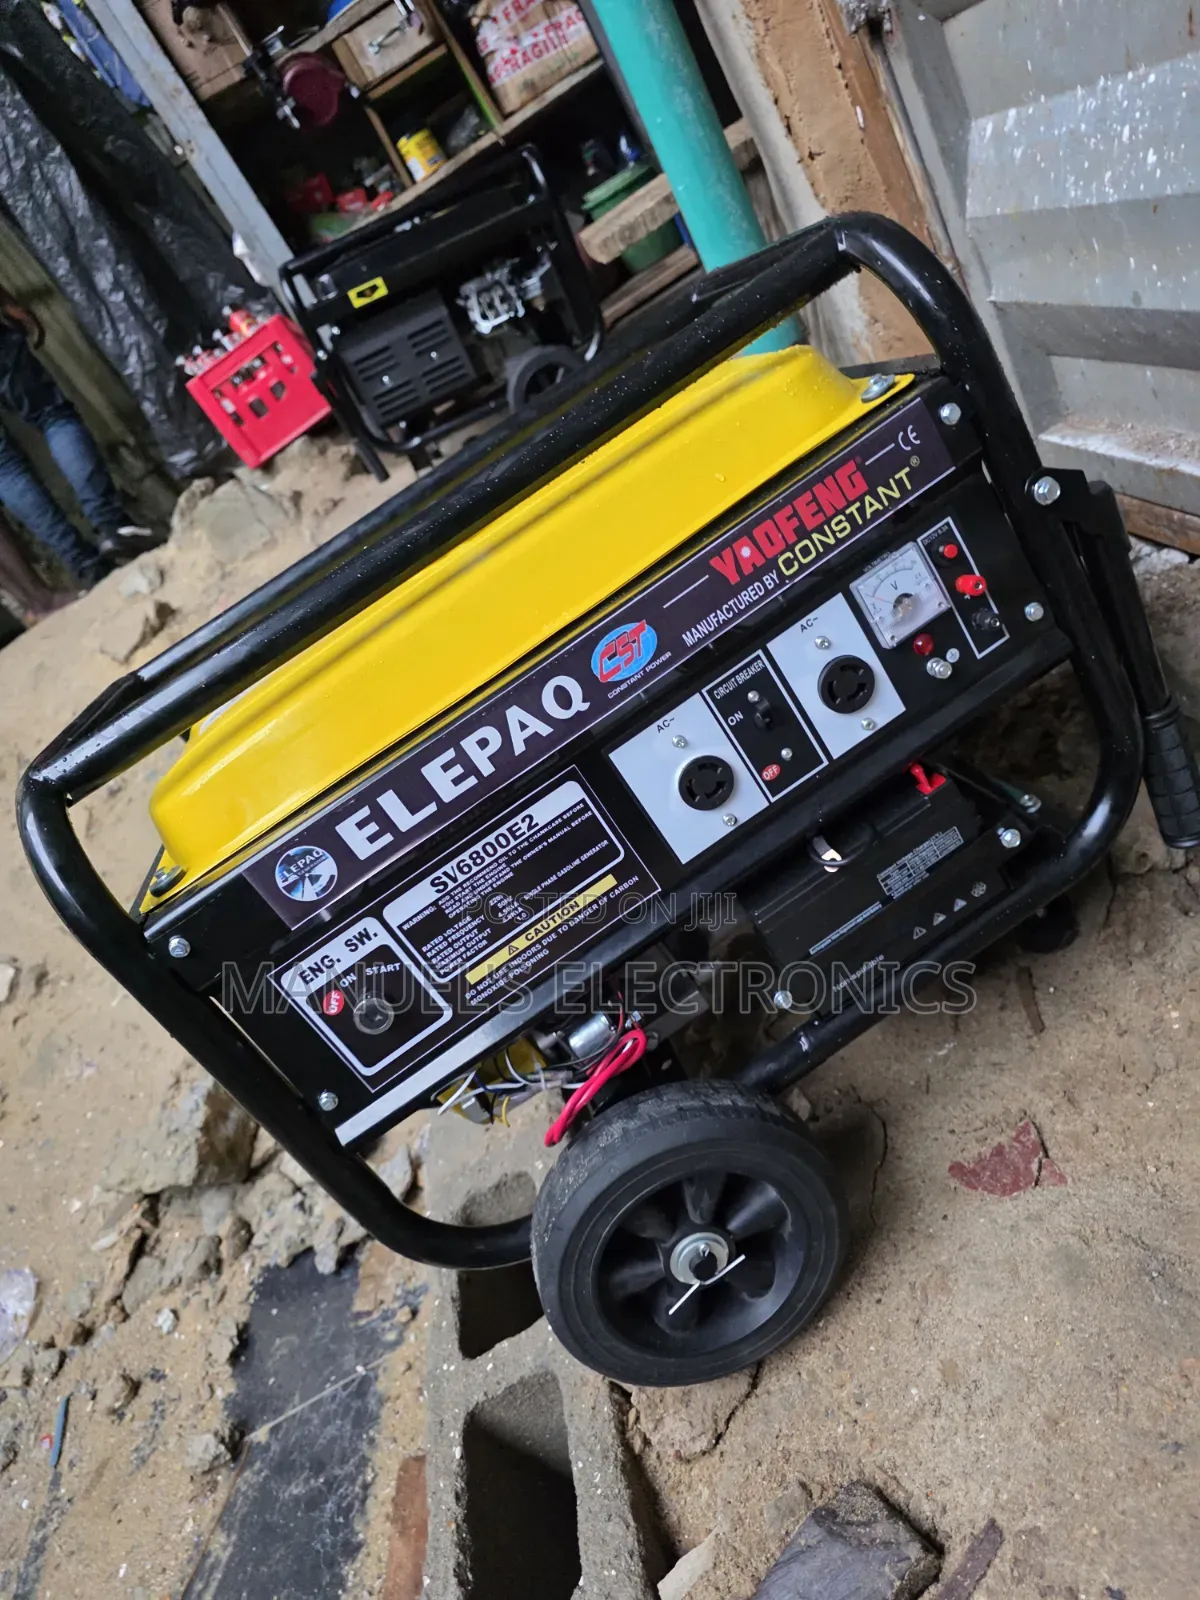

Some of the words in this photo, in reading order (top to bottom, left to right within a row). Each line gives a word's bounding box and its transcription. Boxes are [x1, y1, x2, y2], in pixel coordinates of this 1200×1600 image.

[710, 459, 869, 585] YAOFENG
[682, 582, 765, 647] MANUFACTURED
[763, 570, 780, 590] BY
[778, 467, 912, 577] CONSTANT
[891, 581, 898, 590] V
[598, 620, 649, 683] CST
[606, 670, 645, 698] CONSTANT
[644, 651, 672, 672] POWER
[712, 677, 739, 699] CIRCUIT
[734, 659, 765, 684] BREAKER
[726, 710, 744, 726] ON
[335, 675, 591, 861] ELEPAQ
[762, 766, 780, 780] OFF
[402, 904, 437, 930] WARNING:
[437, 895, 449, 905] ADD
[450, 886, 462, 896] THE
[462, 861, 498, 888] RECOMMEND
[497, 854, 508, 863] OIL
[508, 848, 516, 856] TO
[516, 840, 529, 850] THE
[562, 802, 584, 819] BEFORE
[430, 813, 540, 894] SV6800E2
[444, 901, 460, 914] READ
[460, 892, 473, 903] AND
[472, 866, 511, 894] UNDERSTAND
[510, 858, 523, 868] THE
[522, 841, 547, 860] OWNER'S
[547, 824, 571, 843] MANUAL
[570, 810, 592, 827] BEFORE
[523, 885, 542, 900] SINGLE
[540, 874, 557, 888] PHASE
[556, 858, 581, 877] GASOLINE
[579, 839, 609, 861] GENERATOR
[441, 898, 454, 909] YOU
[454, 886, 473, 900] START
[472, 877, 485, 887] THE
[484, 862, 507, 879] ENGINE
[447, 894, 481, 918] OPERATING
[480, 886, 493, 896] THE
[492, 871, 514, 888] ENGINE
[421, 934, 444, 952] RATED
[442, 914, 472, 937] VOLTAGE
[426, 940, 448, 958] RATED
[447, 914, 486, 943] FREQUENCY
[464, 988, 477, 999] DO
[476, 977, 492, 991] NOT
[492, 966, 508, 979] USE
[508, 942, 542, 968] INDOORS
[541, 931, 557, 945] DUE
[556, 923, 569, 934] TO
[567, 902, 599, 926] DANGER
[597, 895, 609, 906] OF
[608, 874, 639, 898] CARBON
[523, 900, 580, 942] CAUTION
[297, 949, 341, 985] ENG.
[343, 923, 378, 954] SW.
[430, 946, 453, 964] RATED
[452, 928, 479, 948] OUTPUT
[435, 945, 466, 969] MAXIMUM
[465, 927, 492, 948] OUTPUT
[439, 956, 462, 975] POWER
[461, 939, 488, 959] FACTOR
[338, 971, 357, 988] ON
[365, 962, 401, 977] START
[469, 976, 509, 1006] MONOXIDE
[508, 947, 550, 978] POISONING
[327, 991, 342, 1014] OFF
